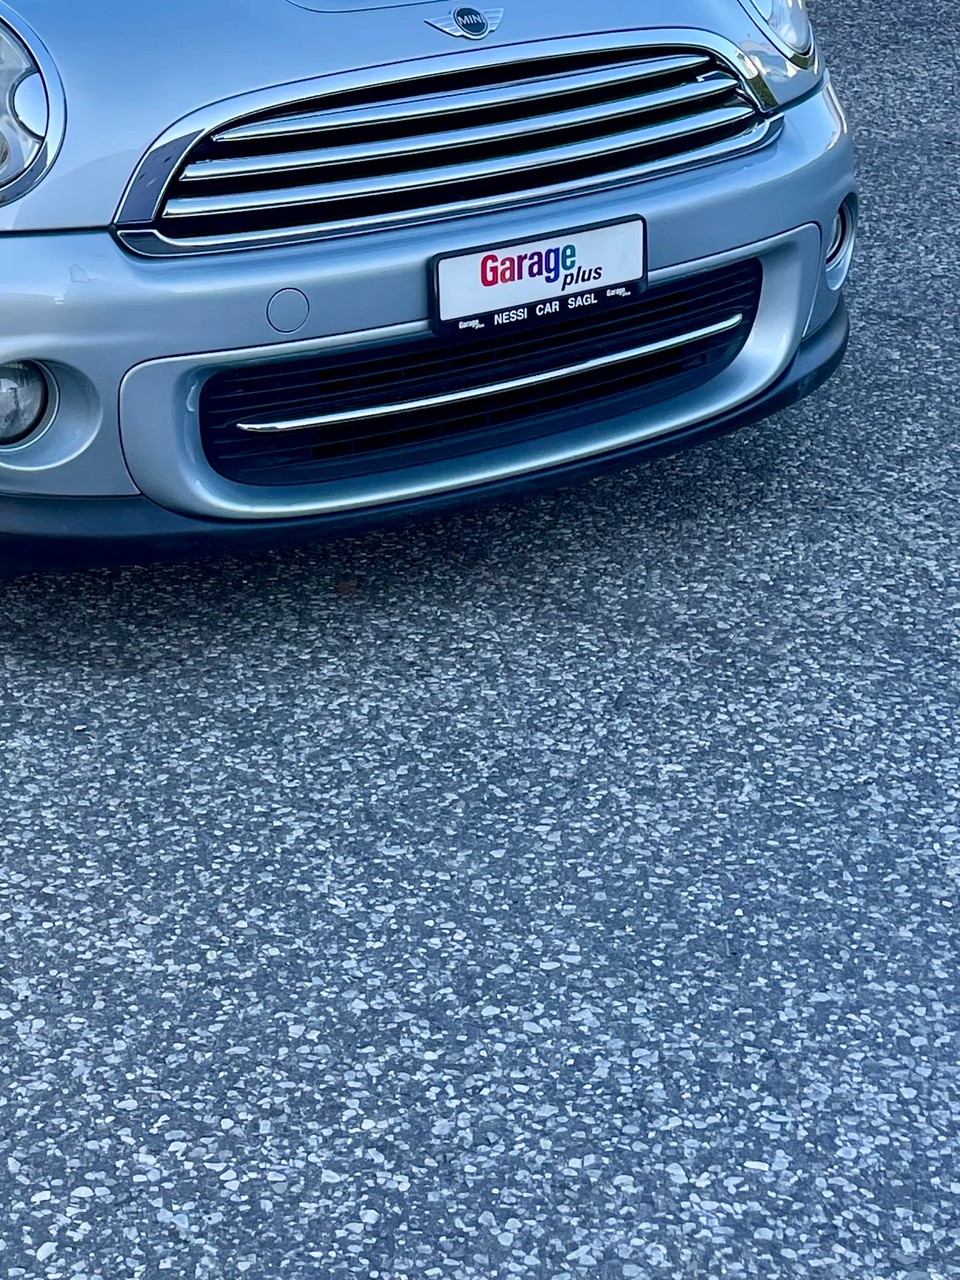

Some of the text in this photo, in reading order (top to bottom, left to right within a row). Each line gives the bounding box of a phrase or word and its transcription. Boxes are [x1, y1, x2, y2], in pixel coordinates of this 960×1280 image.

[457, 14, 486, 25] MINI
[480, 244, 576, 287] Garage
[561, 265, 603, 291] plus
[458, 319, 479, 329] Garage
[494, 307, 528, 326] NESSI
[535, 300, 560, 316] CAR
[567, 293, 598, 309] SAGL
[606, 287, 626, 297] Garage
